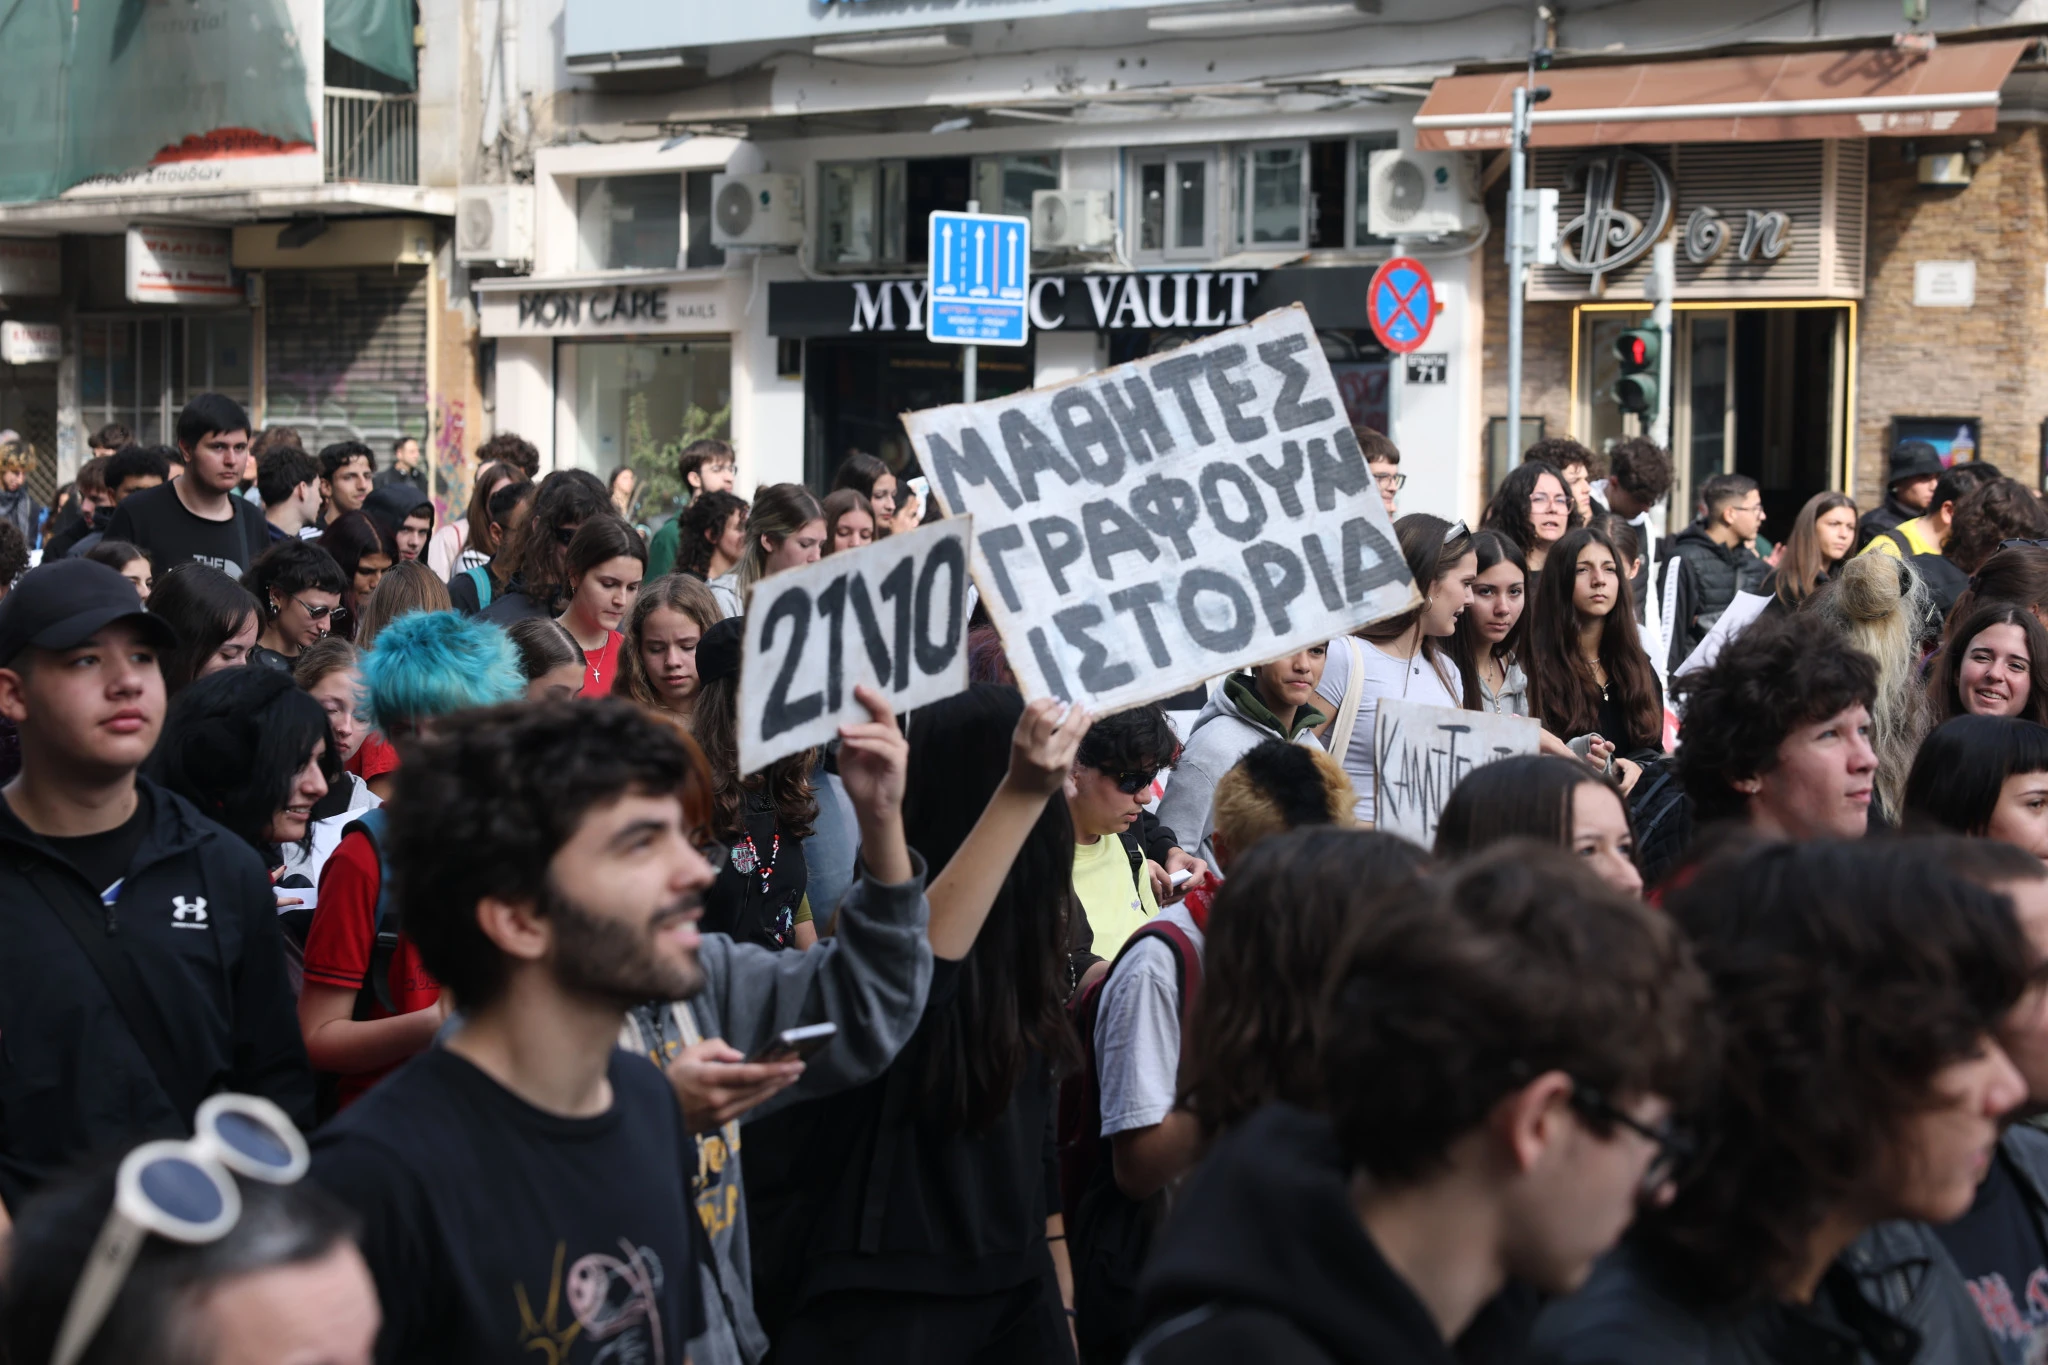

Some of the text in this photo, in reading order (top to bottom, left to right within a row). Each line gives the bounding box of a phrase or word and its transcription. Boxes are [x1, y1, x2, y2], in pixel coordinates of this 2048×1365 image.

[1556, 147, 1792, 296] Don
[518, 285, 716, 326] MON CARE NAILS
[849, 271, 1259, 332] MYC VAULT
[925, 332, 1336, 515] ΜΑΘΗΤΕΣ
[1416, 366, 1439, 383] 71
[192, 554, 224, 569] THE
[977, 426, 1371, 614] ΓΡΑΦΟΥΝ
[1026, 516, 1412, 702] ΙΣΤΟΡΙΑ
